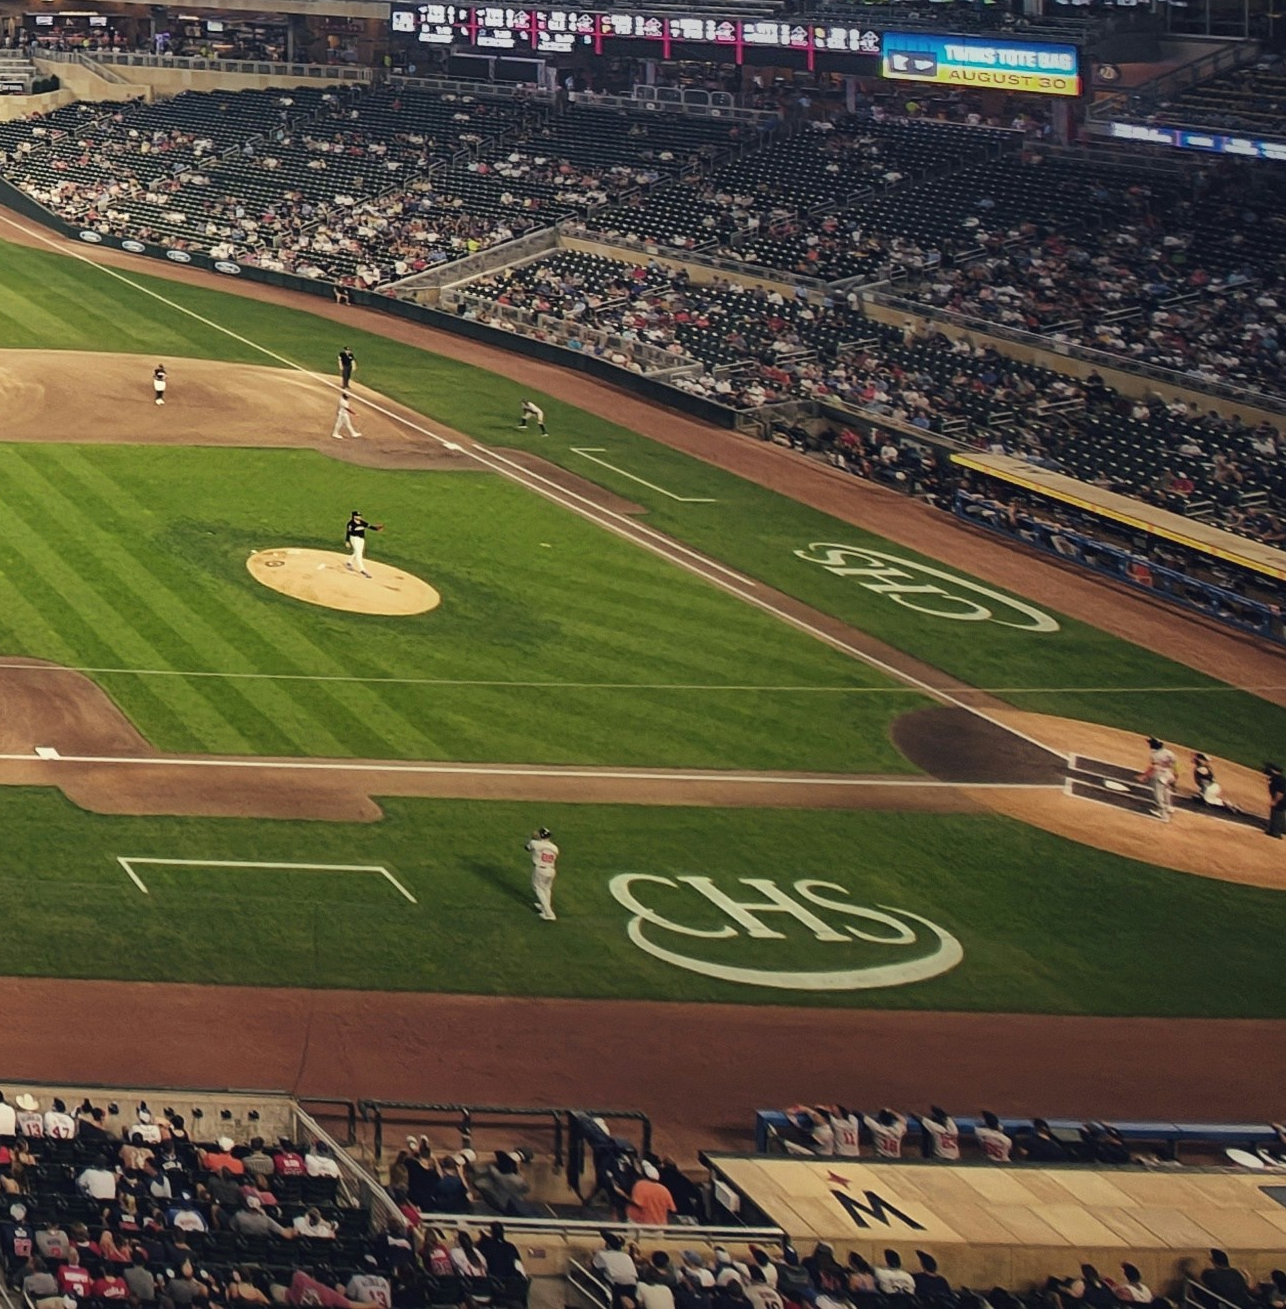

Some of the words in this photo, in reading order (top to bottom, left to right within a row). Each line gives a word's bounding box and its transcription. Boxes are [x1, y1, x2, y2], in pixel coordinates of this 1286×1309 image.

[944, 44, 995, 64] TWINS
[996, 48, 1037, 68] TOTE
[949, 70, 1031, 86] AUGUST
[1038, 78, 1066, 89] 30
[609, 871, 918, 945] CHS
[26, 1124, 42, 1138] 13
[53, 1126, 70, 1140] 47
[830, 1190, 927, 1231] M
